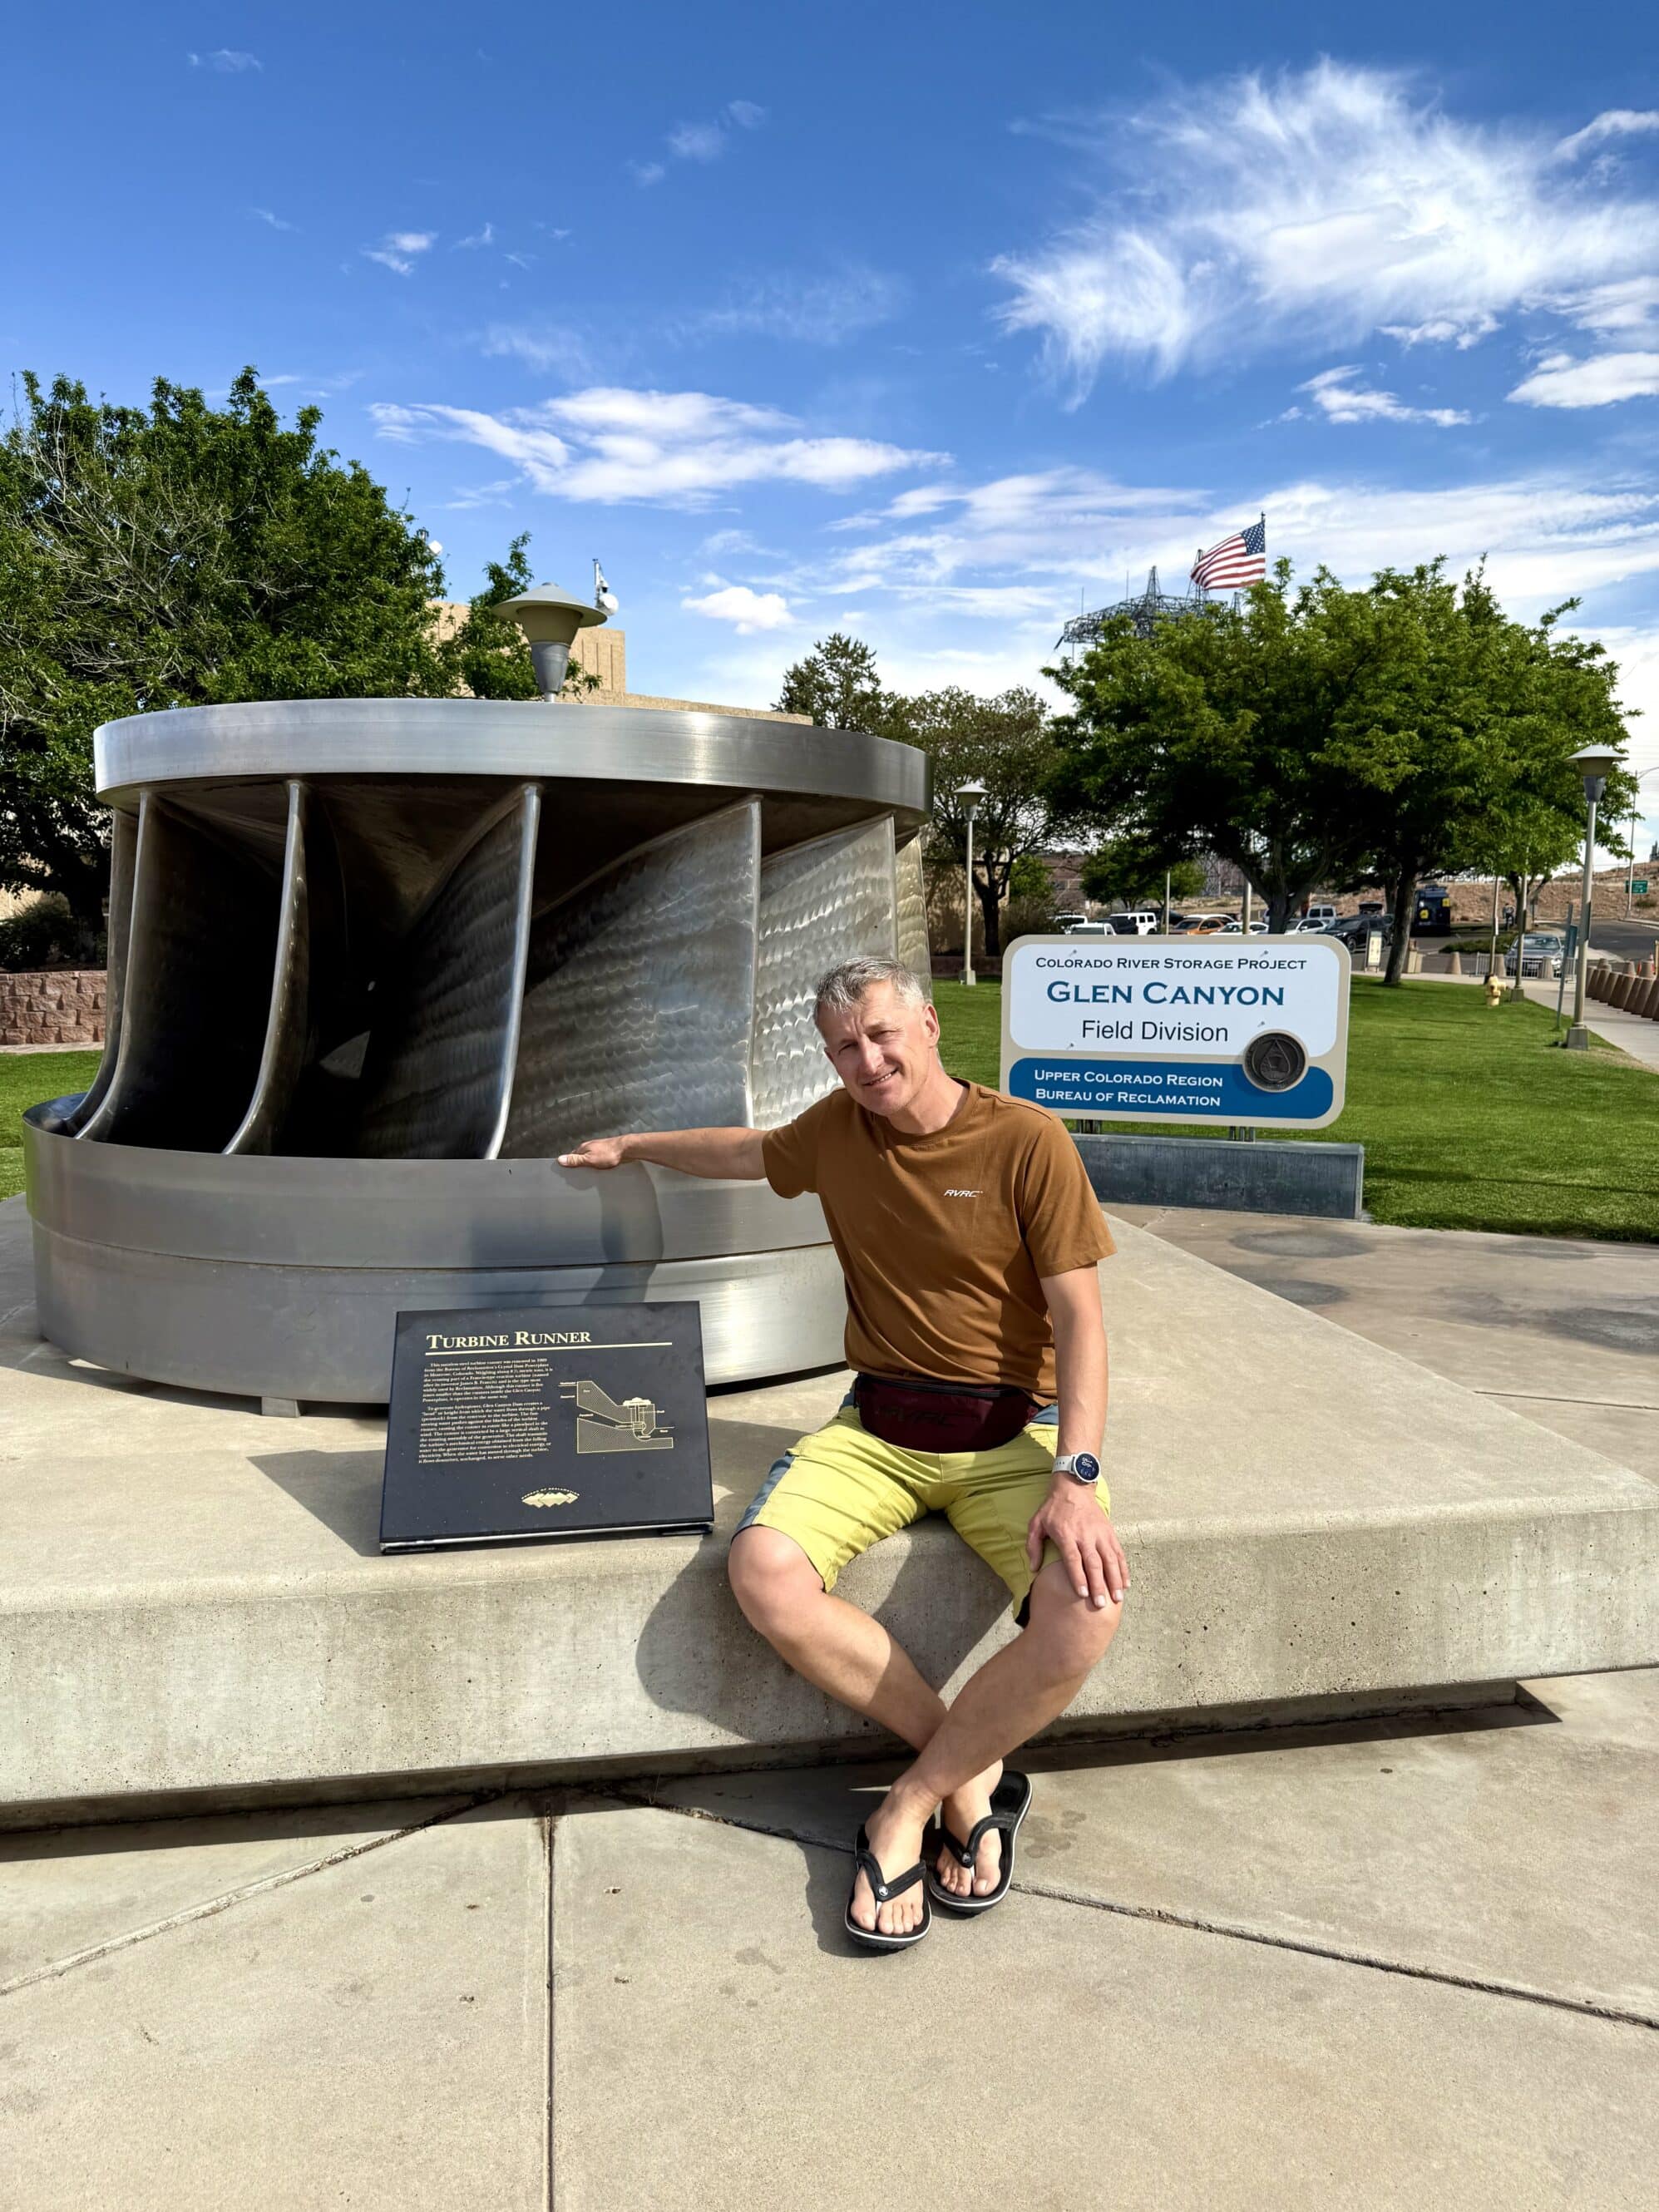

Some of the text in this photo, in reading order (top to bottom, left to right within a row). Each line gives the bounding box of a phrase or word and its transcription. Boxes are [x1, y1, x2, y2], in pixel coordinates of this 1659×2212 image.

[1035, 957, 1307, 970] COLORADO RIVER STORAGE PROJECT
[1046, 980, 1285, 1006] GLEN CANYON
[1082, 1020, 1228, 1042] Field Division
[1034, 1069, 1223, 1087] UPPER COLORADO REGION
[1035, 1088, 1092, 1101] BUREAU
[1118, 1091, 1221, 1107] RECLAMATION
[943, 1189, 983, 1197] RVRC
[426, 1331, 592, 1350] TURBINE RUNNER
